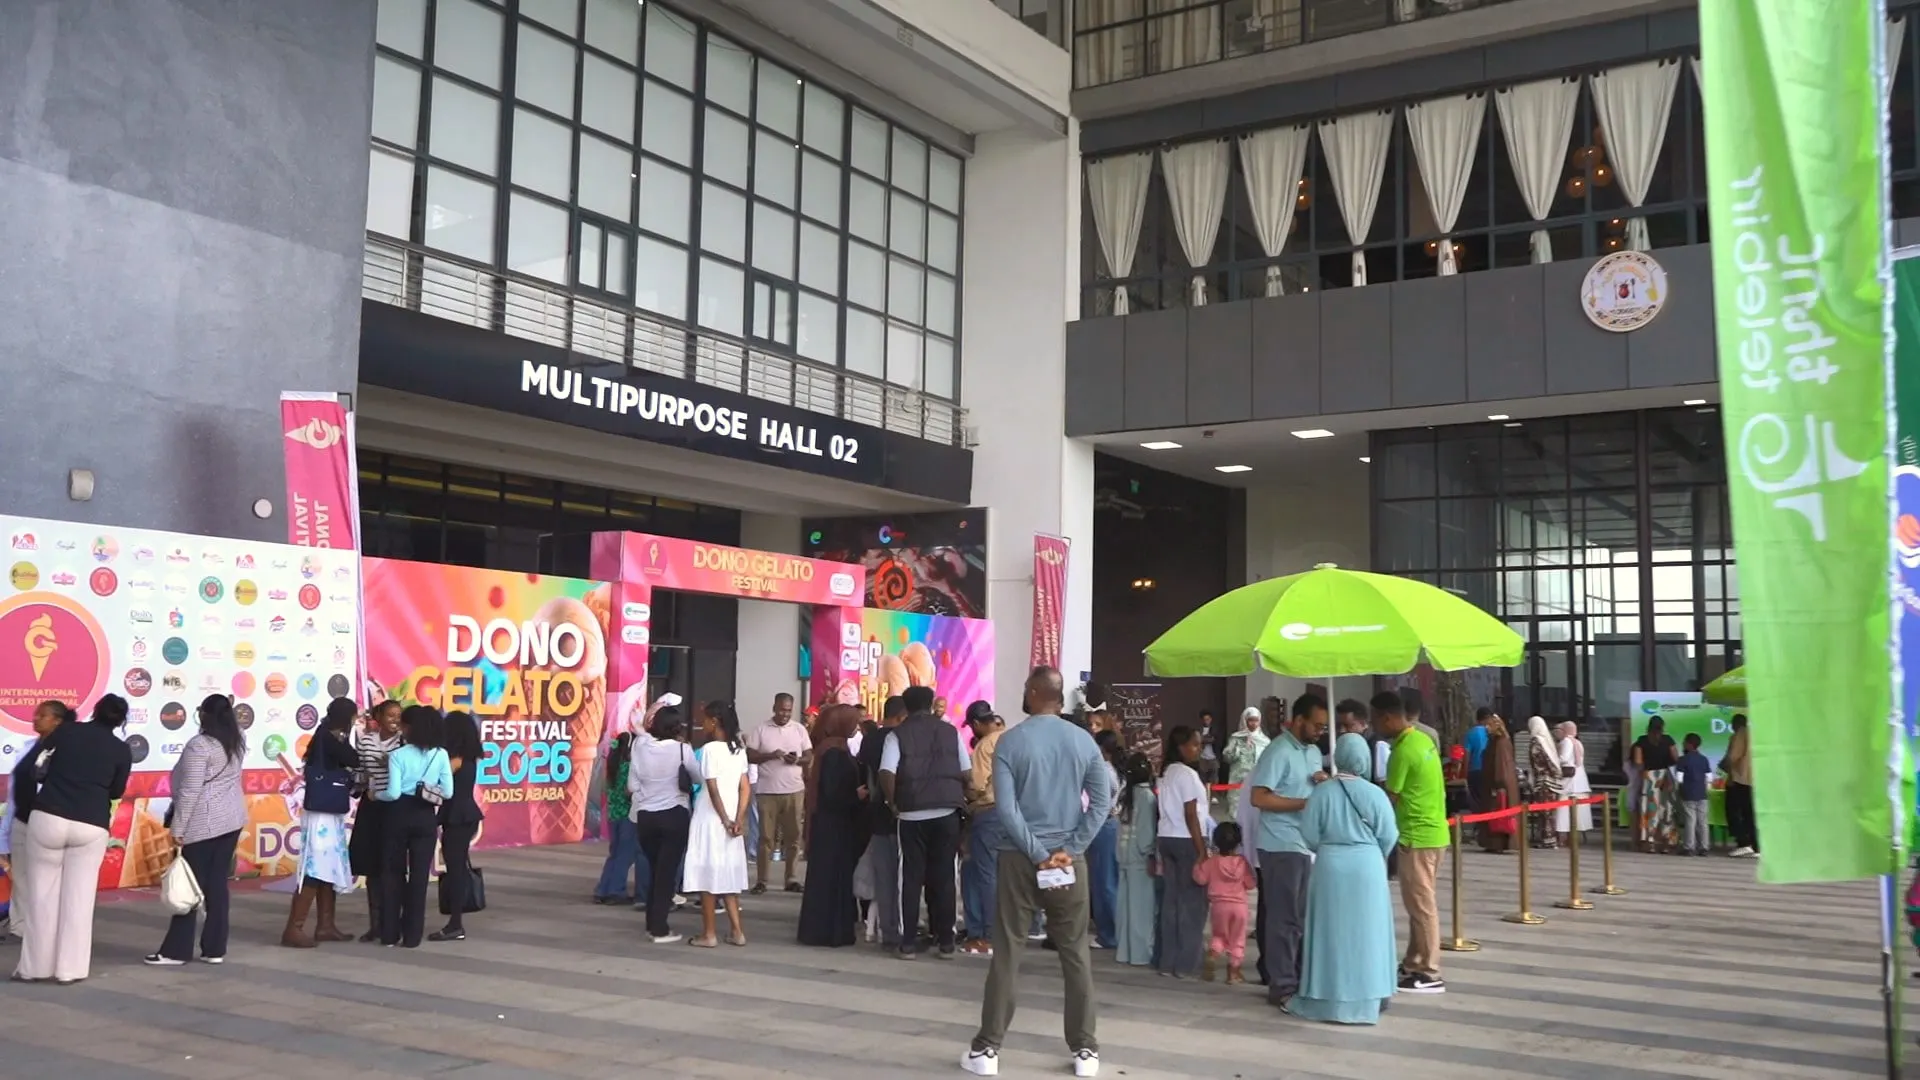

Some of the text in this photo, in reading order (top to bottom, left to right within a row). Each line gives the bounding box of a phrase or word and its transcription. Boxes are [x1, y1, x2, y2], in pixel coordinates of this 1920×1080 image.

[521, 360, 859, 464] MULTIPURPOSE HALL 02
[693, 545, 814, 581] DONO GELATO
[731, 576, 779, 593] FESTIVAL
[446, 614, 585, 668] DONO
[0, 688, 79, 697] INTERNATIONAL
[408, 665, 583, 716] GELATO
[480, 720, 572, 741] FESTIVAL
[475, 742, 573, 785] 2026
[482, 787, 565, 803] ADDIS ABABA
